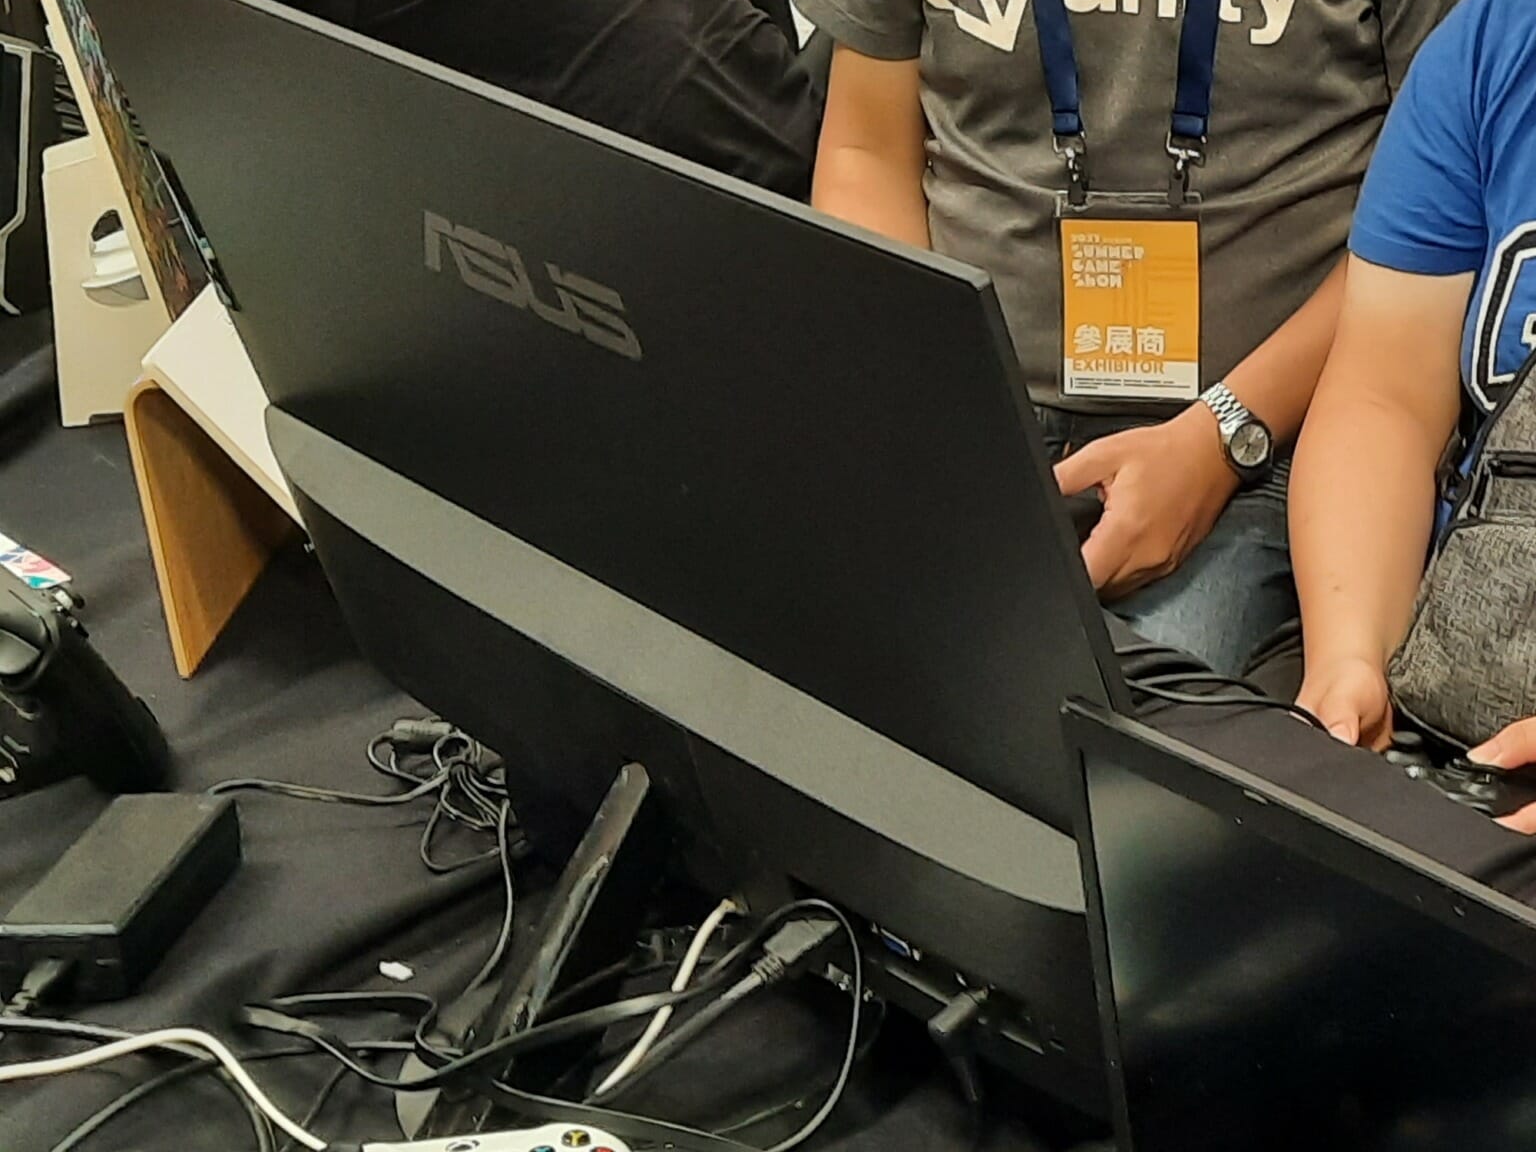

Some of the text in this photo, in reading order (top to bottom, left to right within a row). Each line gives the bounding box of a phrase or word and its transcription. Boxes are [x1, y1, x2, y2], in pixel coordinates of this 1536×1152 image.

[1071, 245, 1145, 260] SUMMER
[1071, 259, 1122, 273] GAME
[423, 210, 643, 362] ASUS
[1072, 358, 1165, 375] EXHIBITOR
